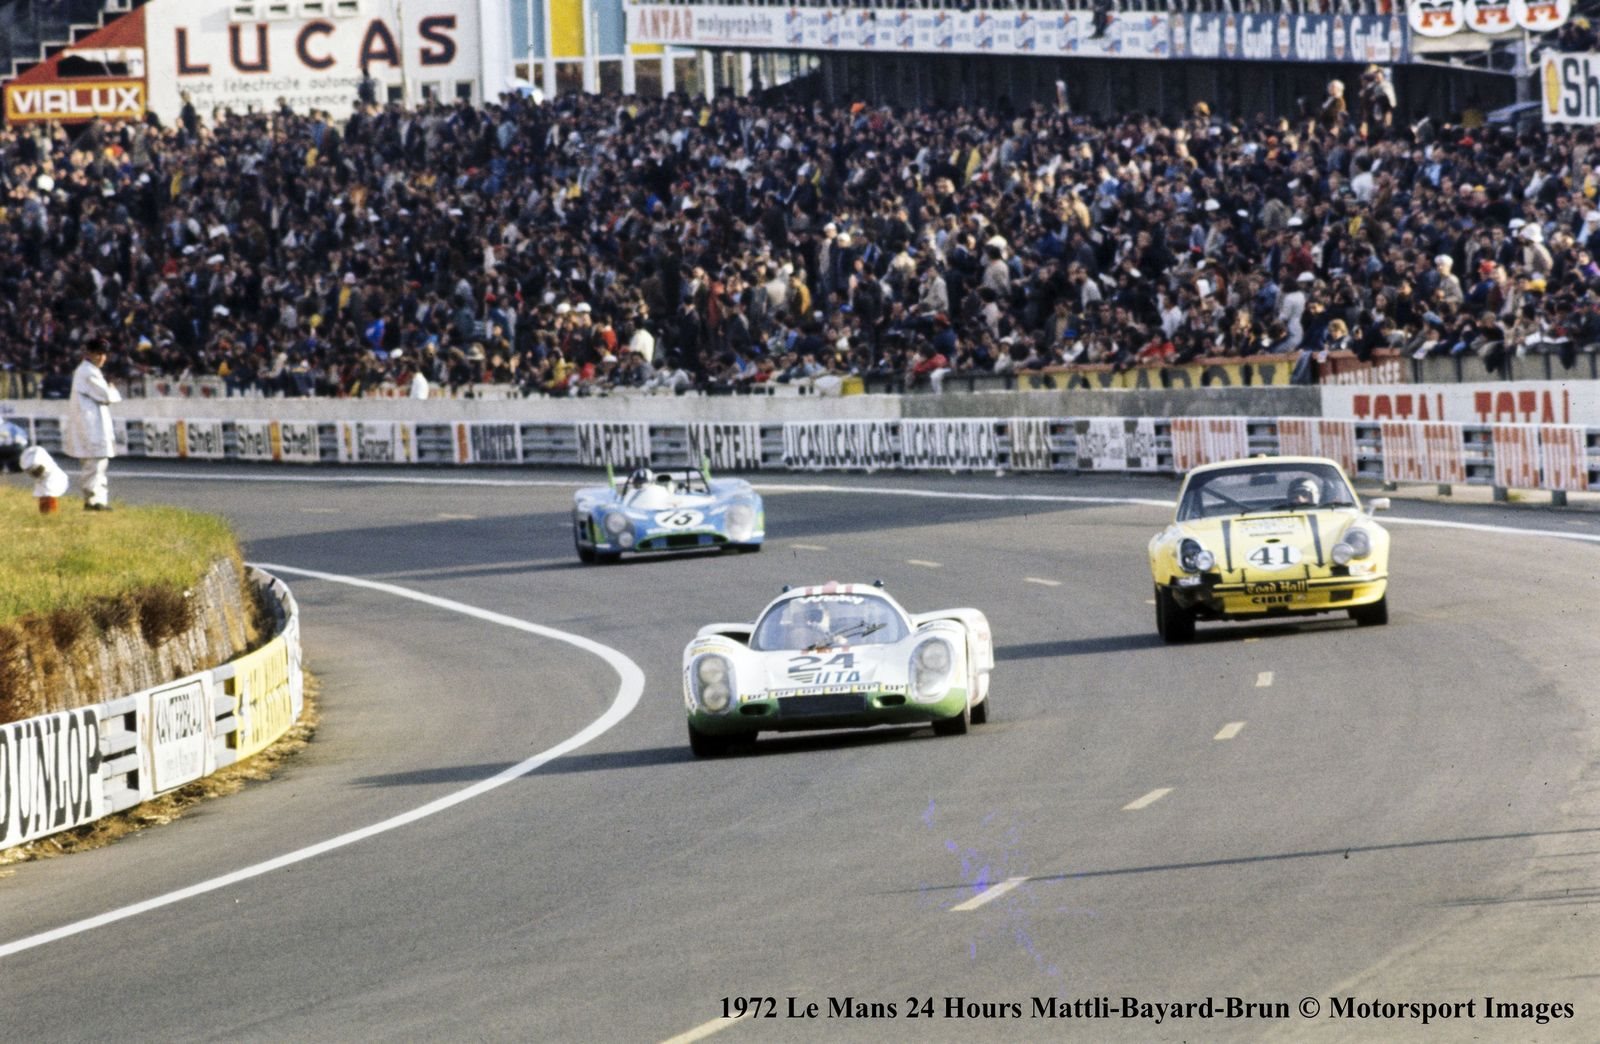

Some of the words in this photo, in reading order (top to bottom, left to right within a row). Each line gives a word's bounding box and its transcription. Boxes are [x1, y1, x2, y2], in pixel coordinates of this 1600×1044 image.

[638, 9, 693, 39] ANTAR
[1190, 13, 1220, 57] Gulf
[1242, 14, 1273, 58] Gulf
[1295, 15, 1328, 60] Gulf
[1350, 15, 1384, 61] Gulf
[175, 15, 457, 76] LUCAS
[13, 86, 141, 115] VIALUX
[144, 422, 176, 453] Shell
[188, 422, 222, 453] Shell
[236, 424, 270, 455] Shell
[282, 423, 319, 455] Shell
[578, 423, 649, 468] MARTELL
[688, 423, 760, 470] MARTELL
[1249, 545, 1294, 565] 41
[1246, 582, 1277, 594] Toad
[1280, 580, 1306, 593] Hall
[788, 653, 860, 673] 24
